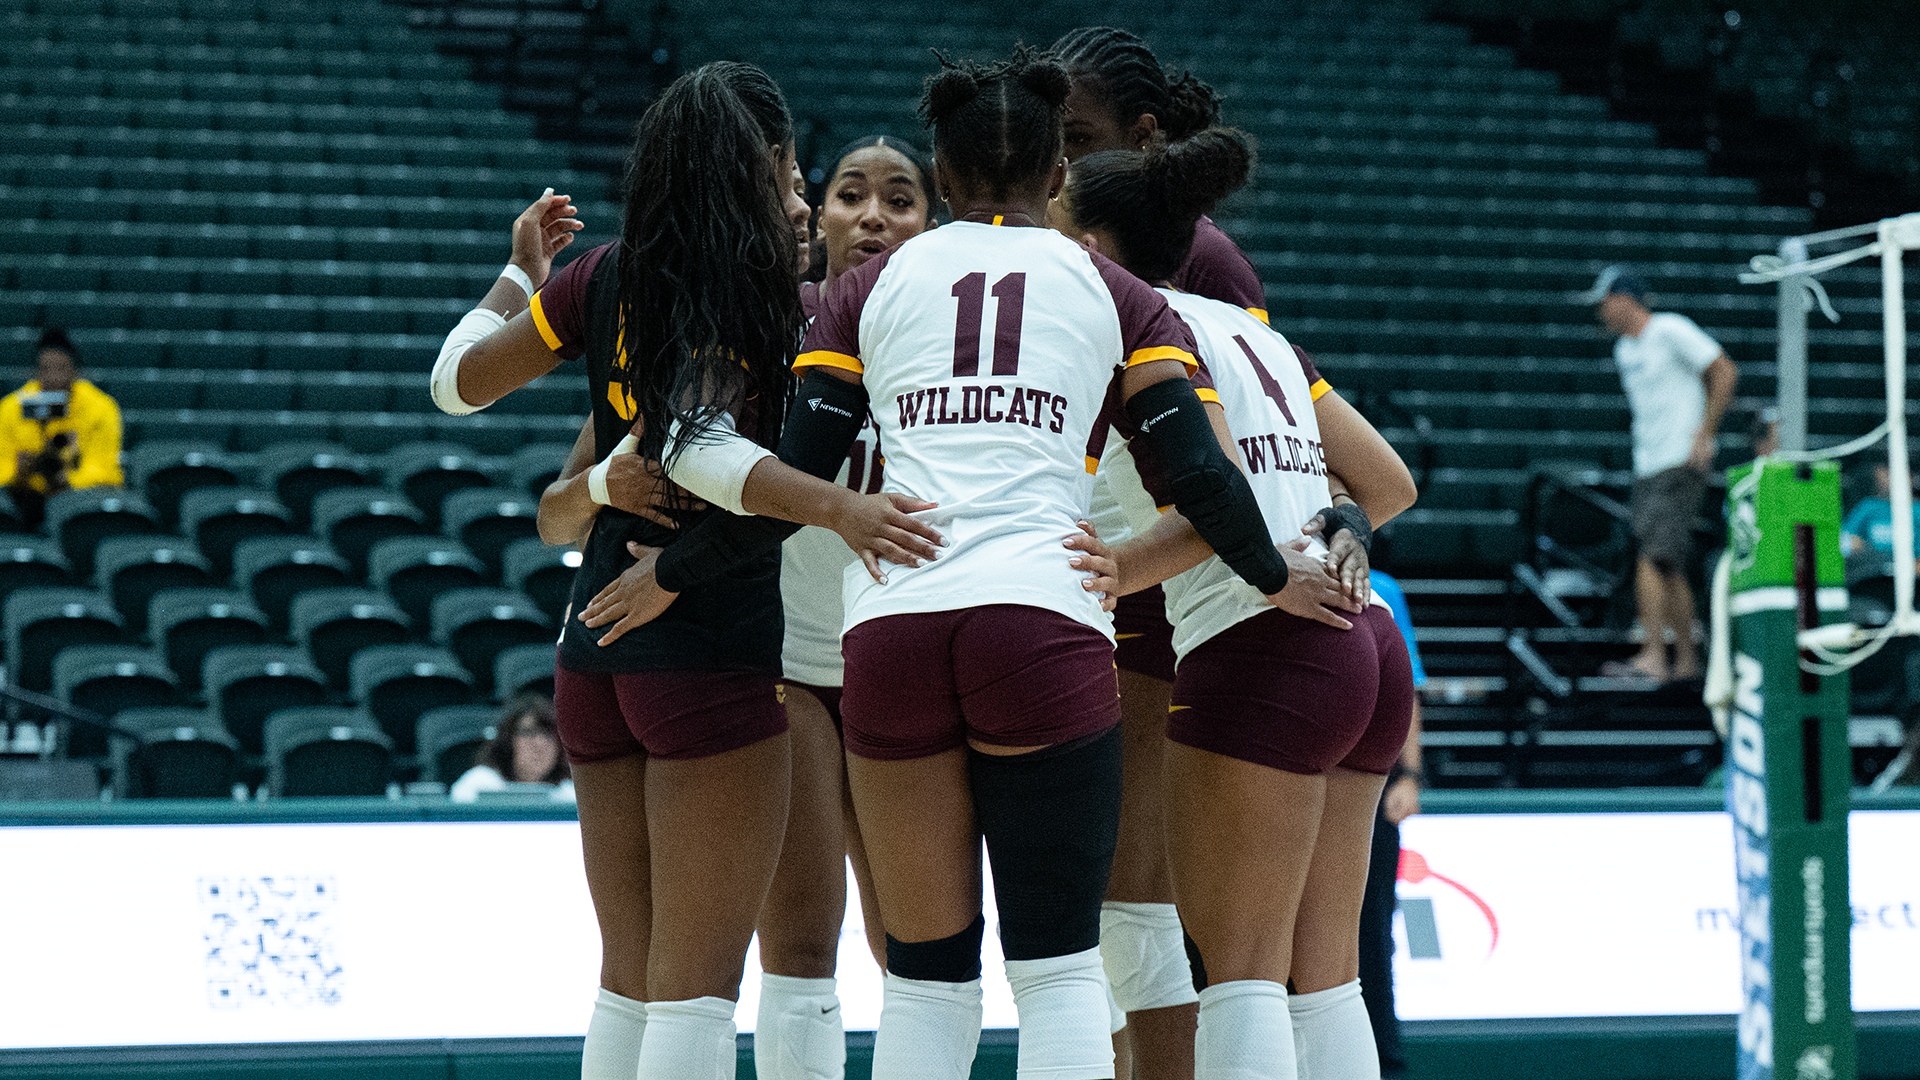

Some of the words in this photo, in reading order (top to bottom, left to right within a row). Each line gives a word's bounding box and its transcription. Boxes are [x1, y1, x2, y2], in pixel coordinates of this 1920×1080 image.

[951, 272, 1026, 377] 11
[897, 385, 1067, 434] WILDCATS
[1733, 652, 1771, 1067] STETSON
